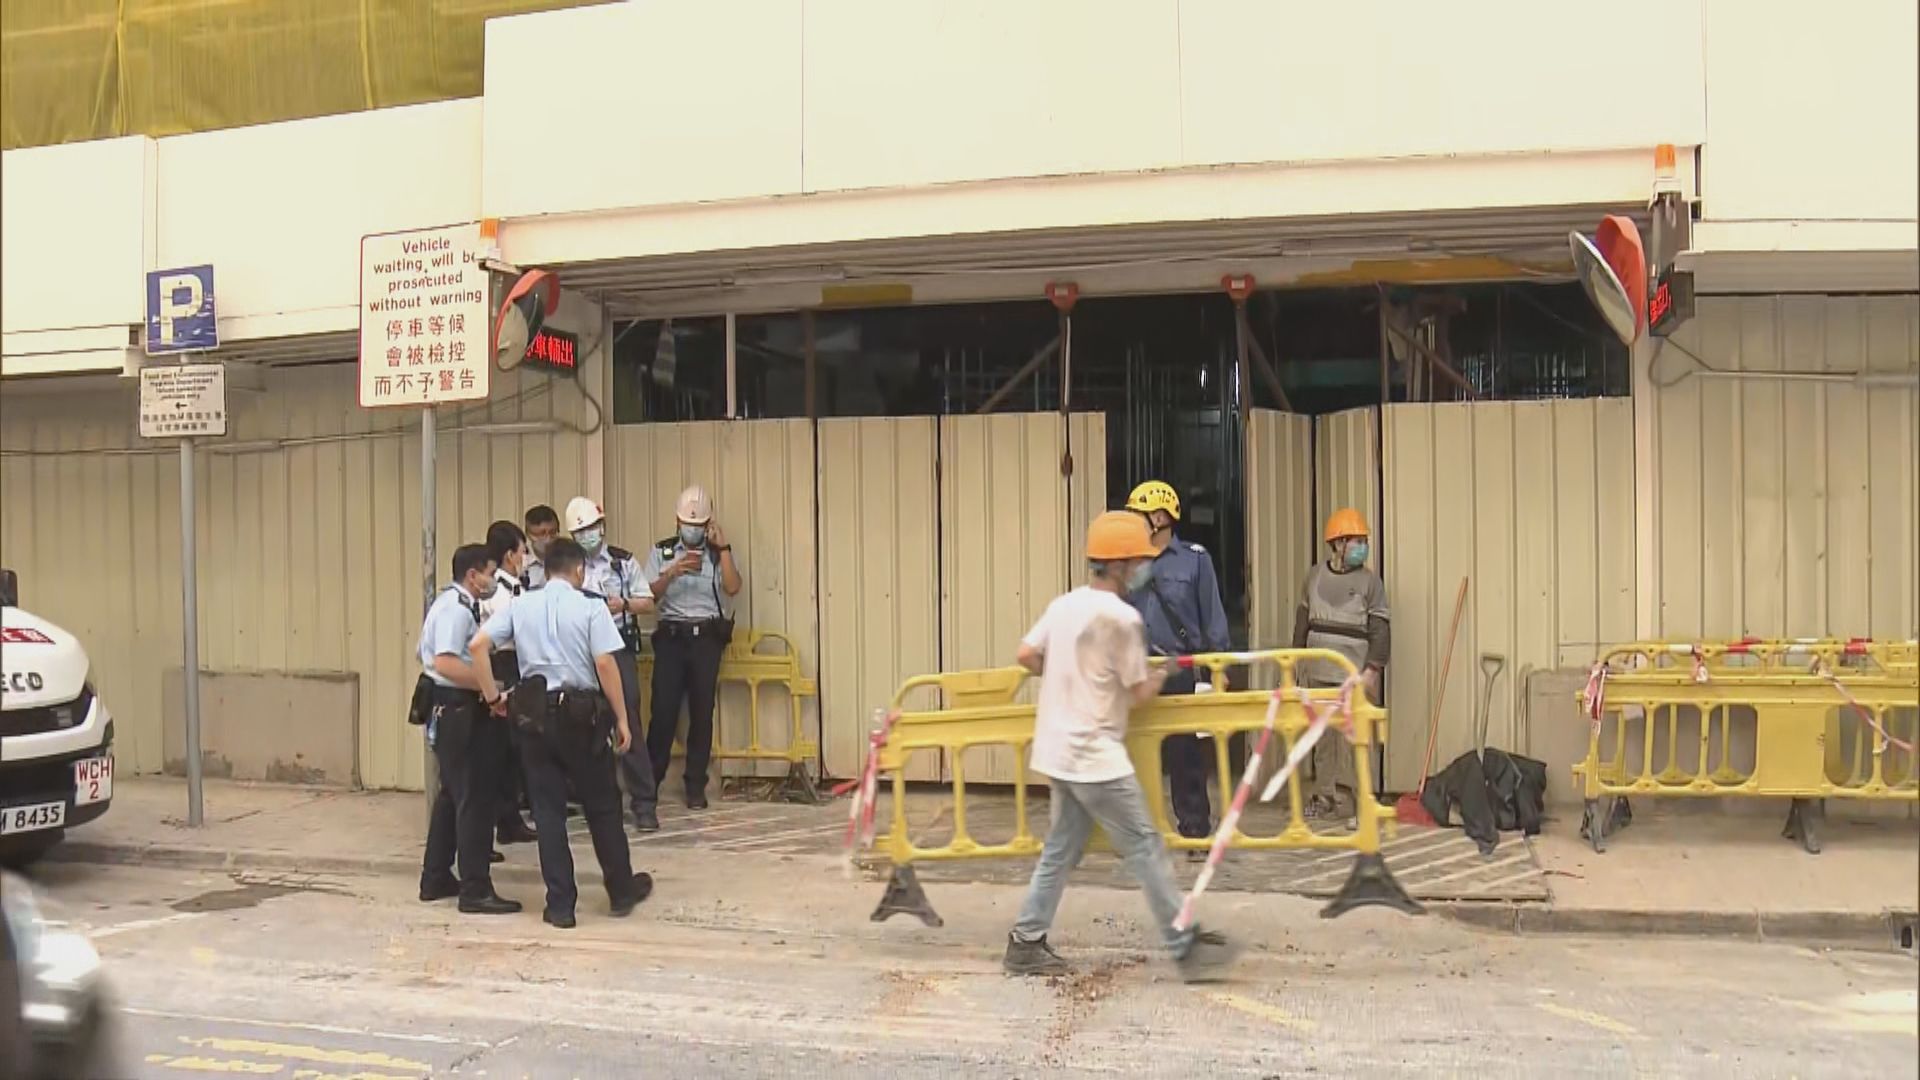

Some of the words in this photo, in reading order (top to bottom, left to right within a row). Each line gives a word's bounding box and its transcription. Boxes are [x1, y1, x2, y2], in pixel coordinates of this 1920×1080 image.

[402, 236, 450, 254] Vehicle
[373, 258, 423, 275] waiting
[432, 253, 454, 268] will
[388, 271, 463, 294] prosecuted
[159, 274, 203, 345] P
[369, 293, 422, 312] without
[430, 289, 482, 305] warning
[386, 314, 465, 341] 停車等候
[386, 341, 466, 368] 會被檢控
[374, 369, 476, 398] 而不予警告
[79, 760, 110, 781] WCH
[89, 780, 99, 800] 2
[15, 806, 60, 829] 8435
